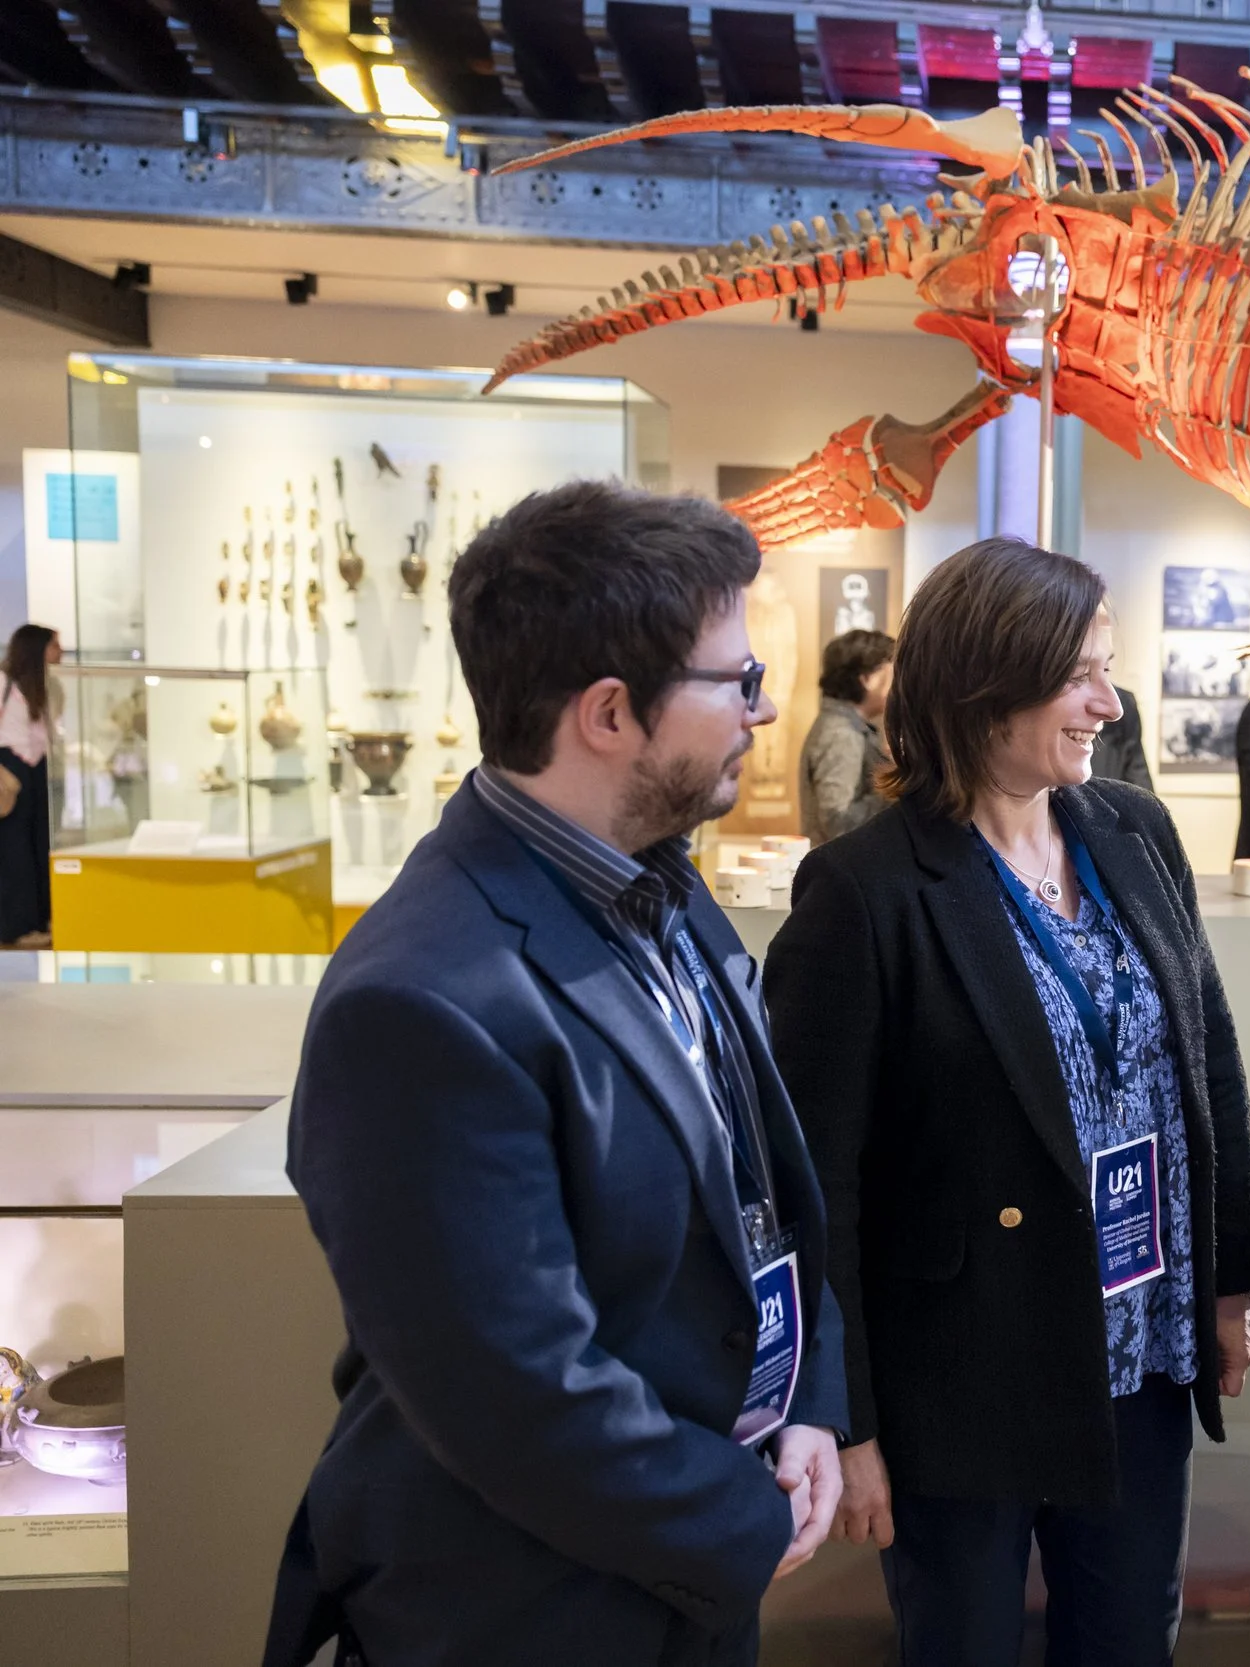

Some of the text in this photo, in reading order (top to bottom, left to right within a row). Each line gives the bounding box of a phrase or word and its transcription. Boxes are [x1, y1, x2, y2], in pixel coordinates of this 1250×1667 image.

[1117, 1002, 1126, 1039] University
[1122, 1002, 1130, 1034] Glasgow
[1108, 1161, 1142, 1195] U21
[1102, 1211, 1151, 1233] Professor Rachel Jordan
[1106, 1242, 1124, 1252] University
